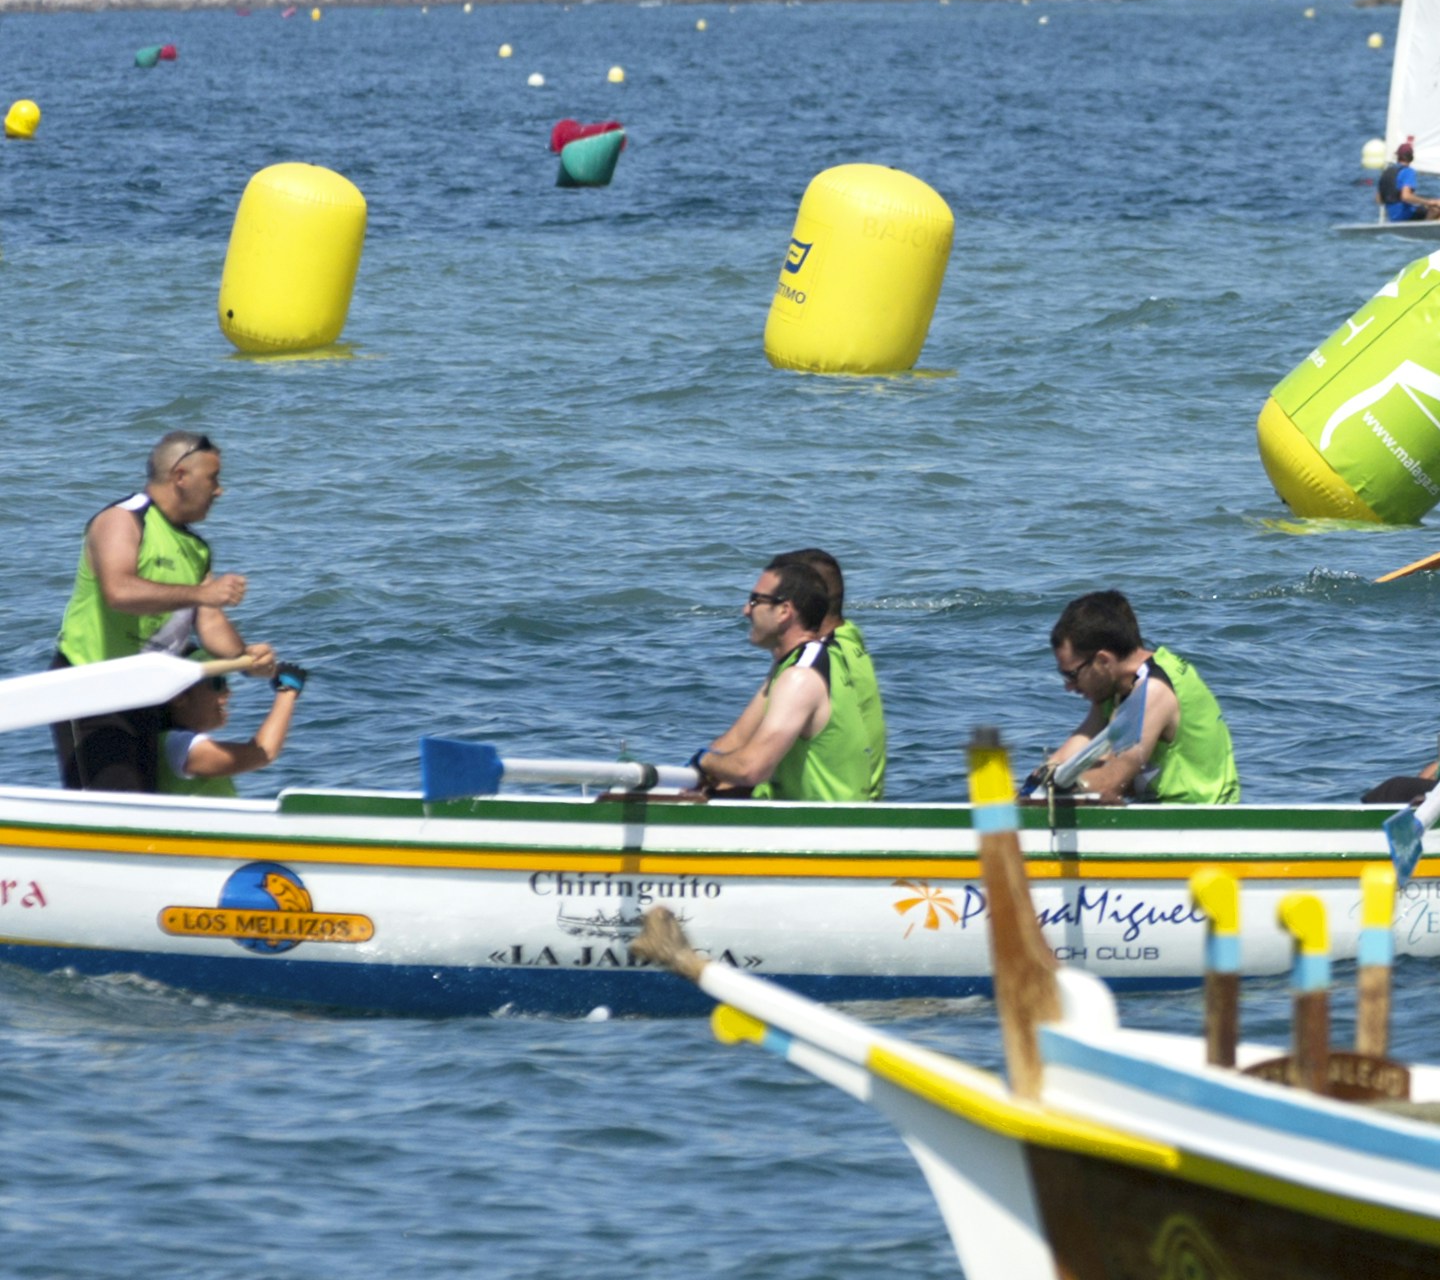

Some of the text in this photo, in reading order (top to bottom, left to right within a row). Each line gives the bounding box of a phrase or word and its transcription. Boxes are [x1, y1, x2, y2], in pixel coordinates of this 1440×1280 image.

[182, 911, 352, 938] LOS MELLIZOS
[1096, 947, 1160, 961] CLUB
